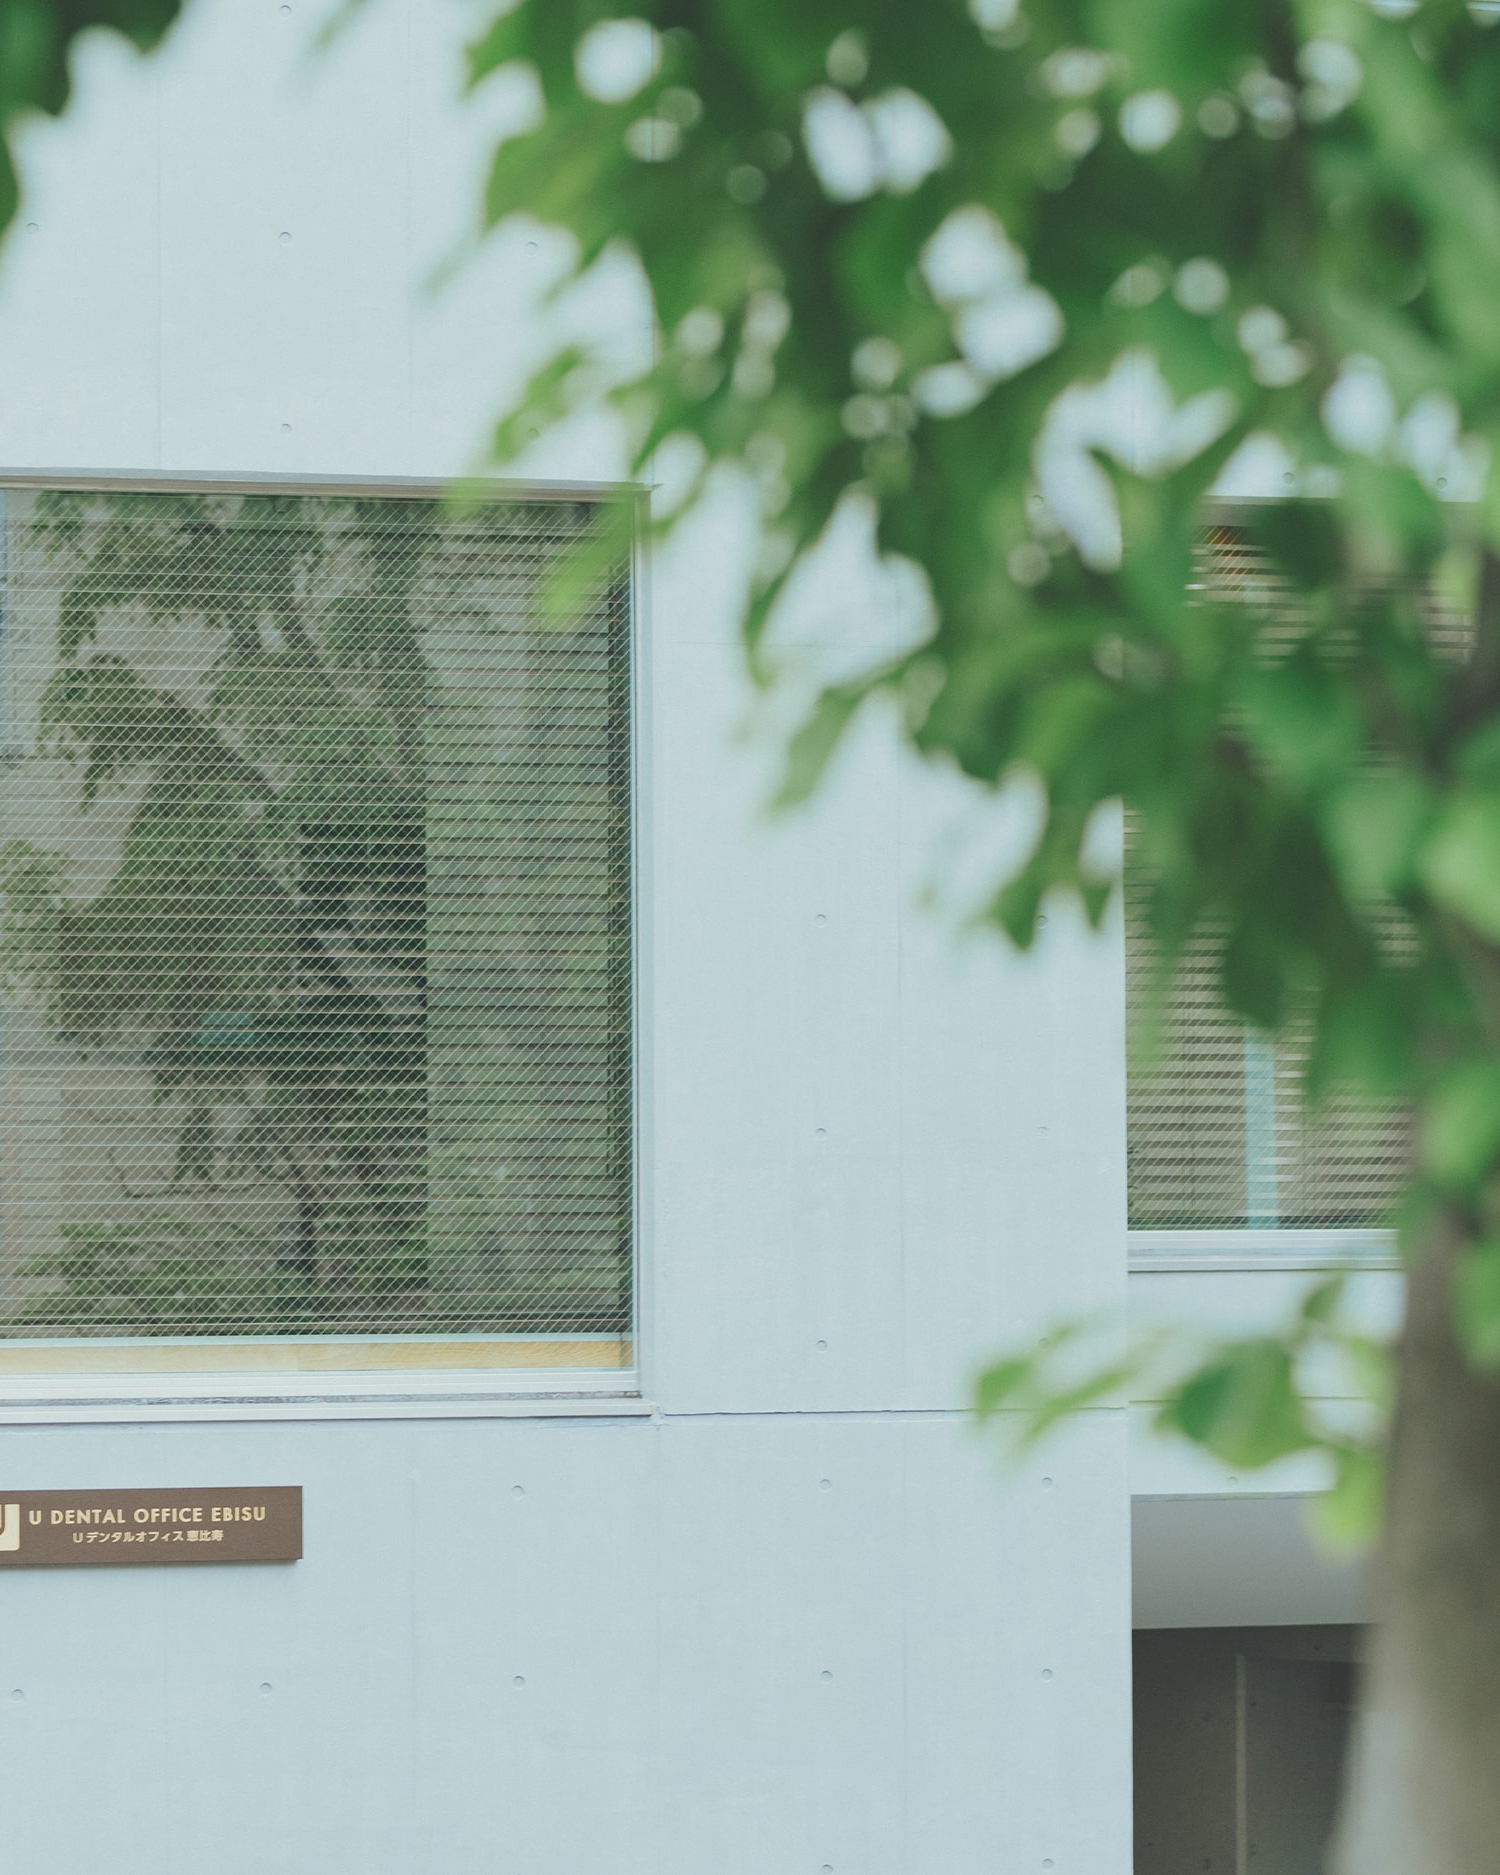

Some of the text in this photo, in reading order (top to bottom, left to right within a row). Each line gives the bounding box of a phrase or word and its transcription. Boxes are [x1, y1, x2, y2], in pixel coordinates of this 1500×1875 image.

[28, 1506, 266, 1525] U DENTAL OFFICE EBISU
